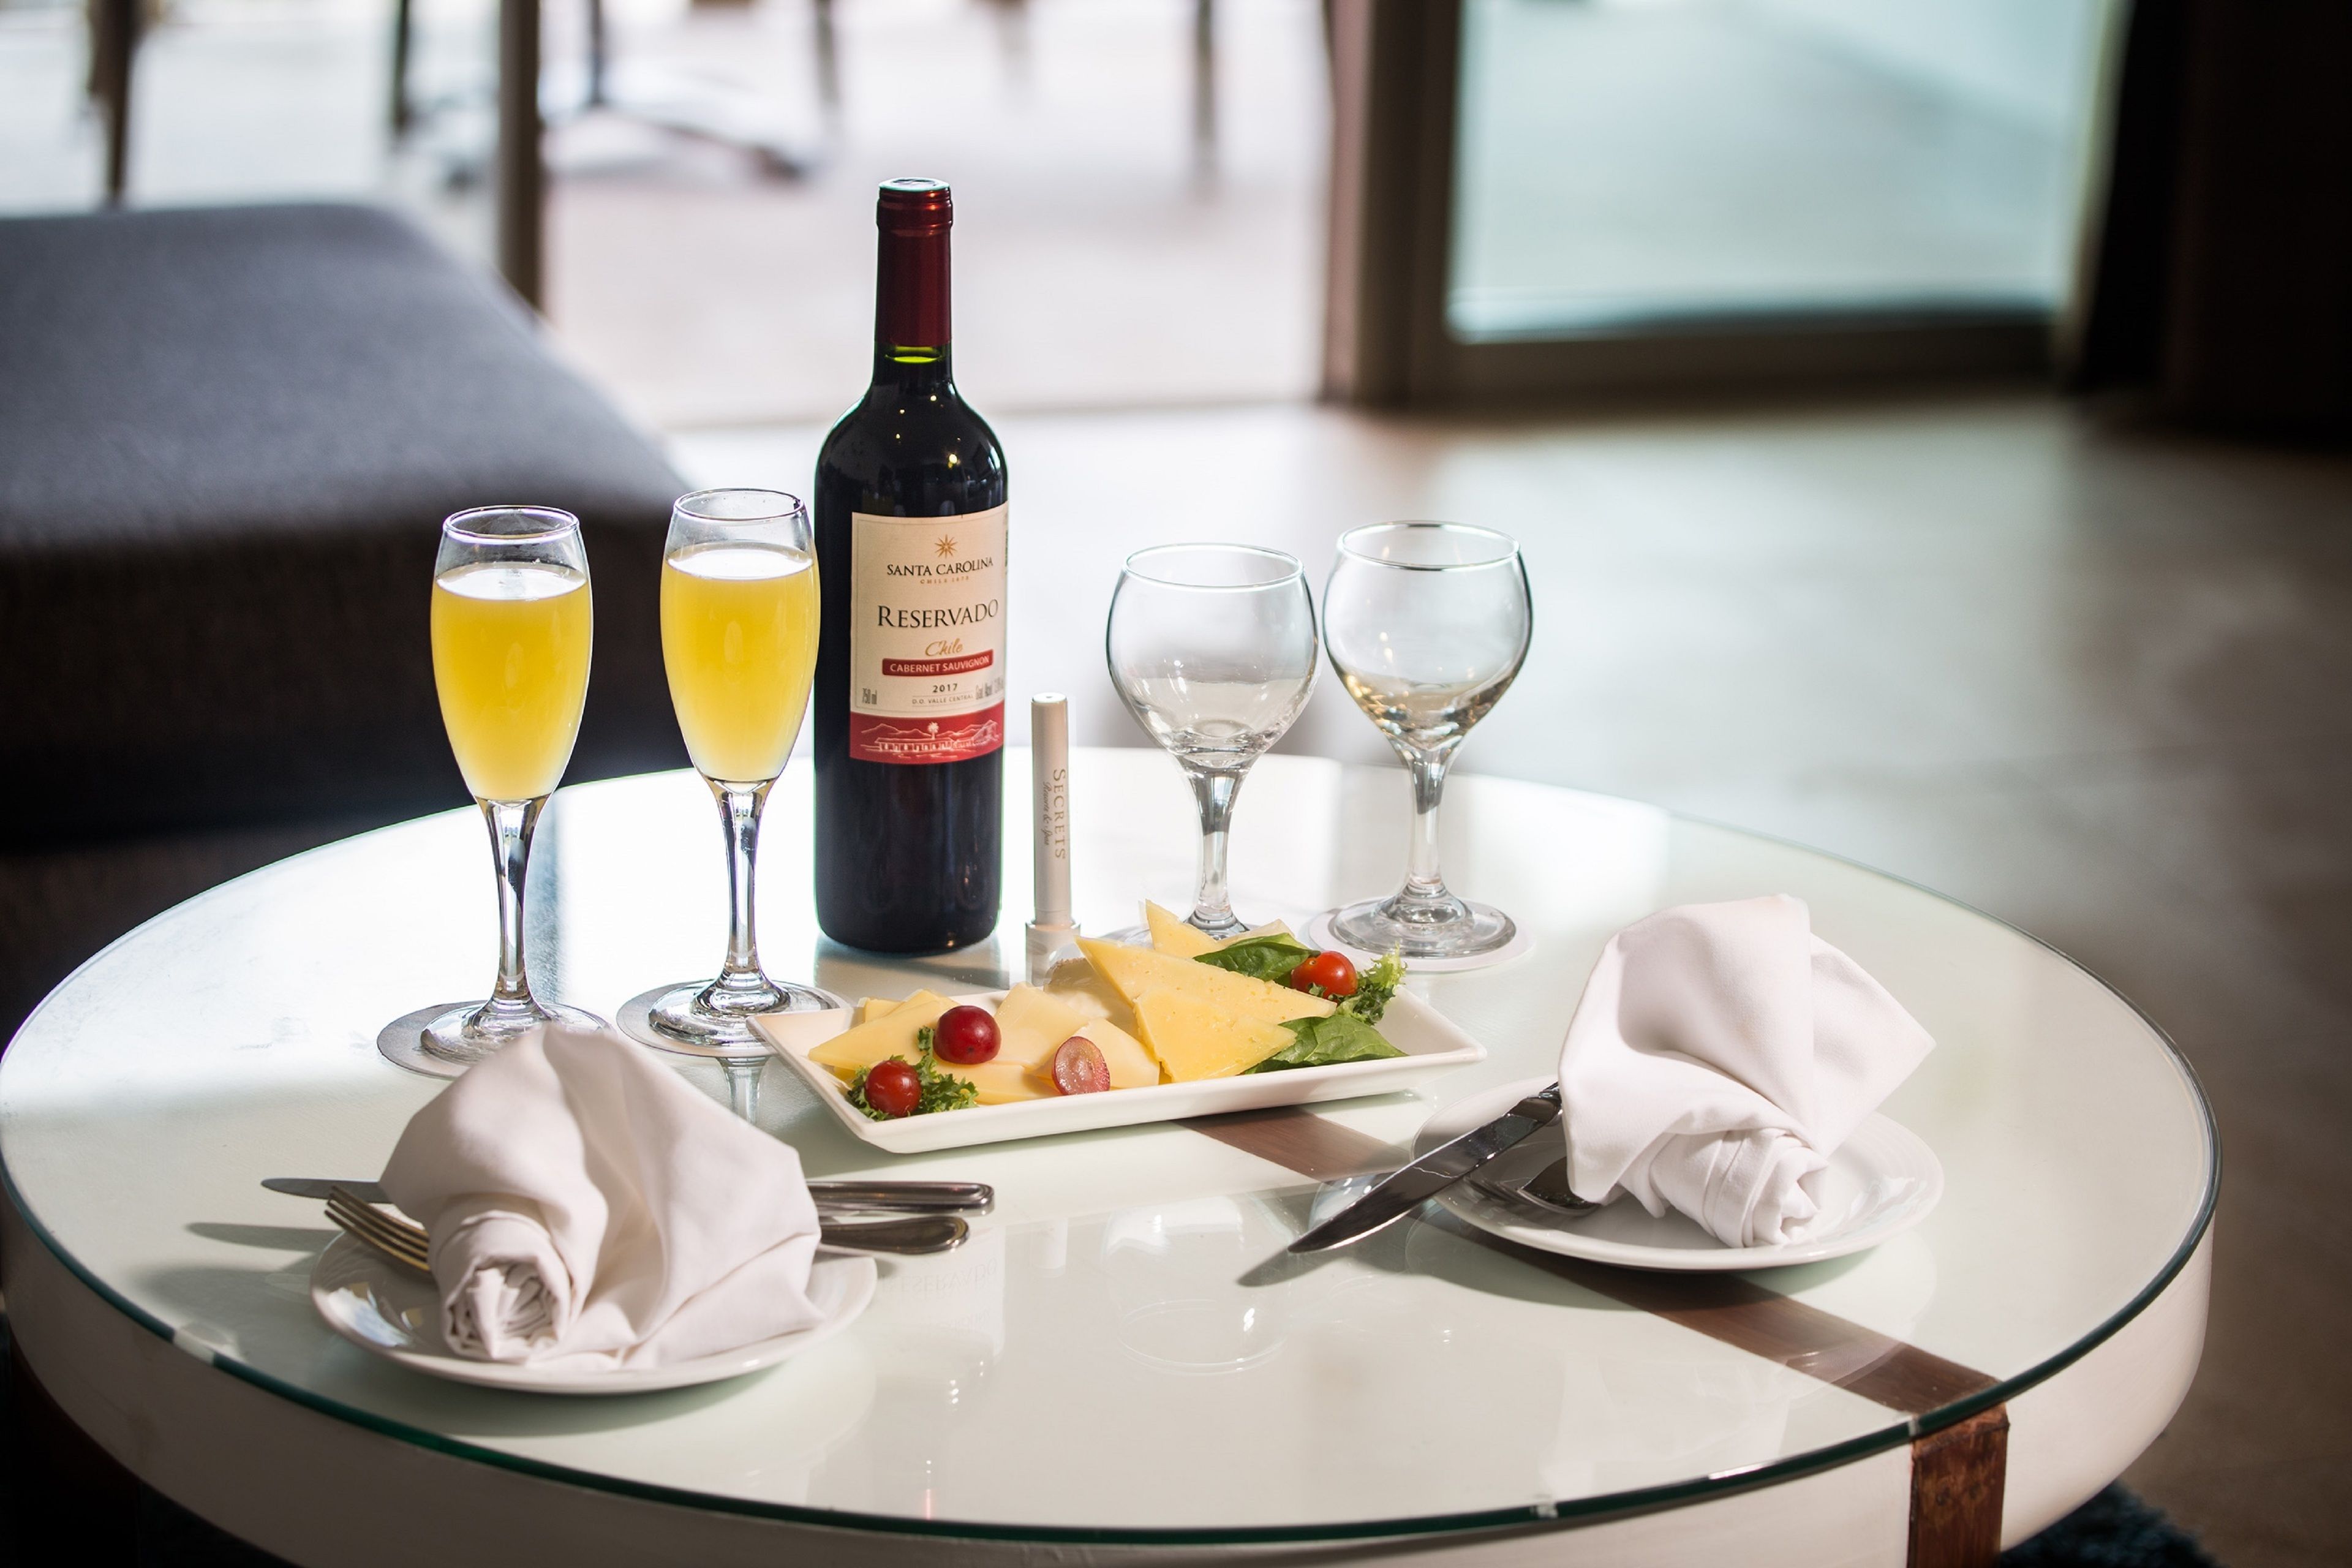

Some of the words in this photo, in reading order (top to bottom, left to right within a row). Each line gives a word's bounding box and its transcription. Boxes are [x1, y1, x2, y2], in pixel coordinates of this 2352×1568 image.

[887, 564, 932, 576] SANTA
[936, 557, 993, 575] CAROLINA
[878, 599, 998, 628] RESERVADO
[925, 638, 963, 657] Chile
[890, 663, 941, 673] CABERNET
[943, 655, 990, 671] SAUVIGNON
[932, 683, 957, 693] 2017
[1042, 814, 1052, 824] &
[1053, 769, 1066, 859] SECRETS
